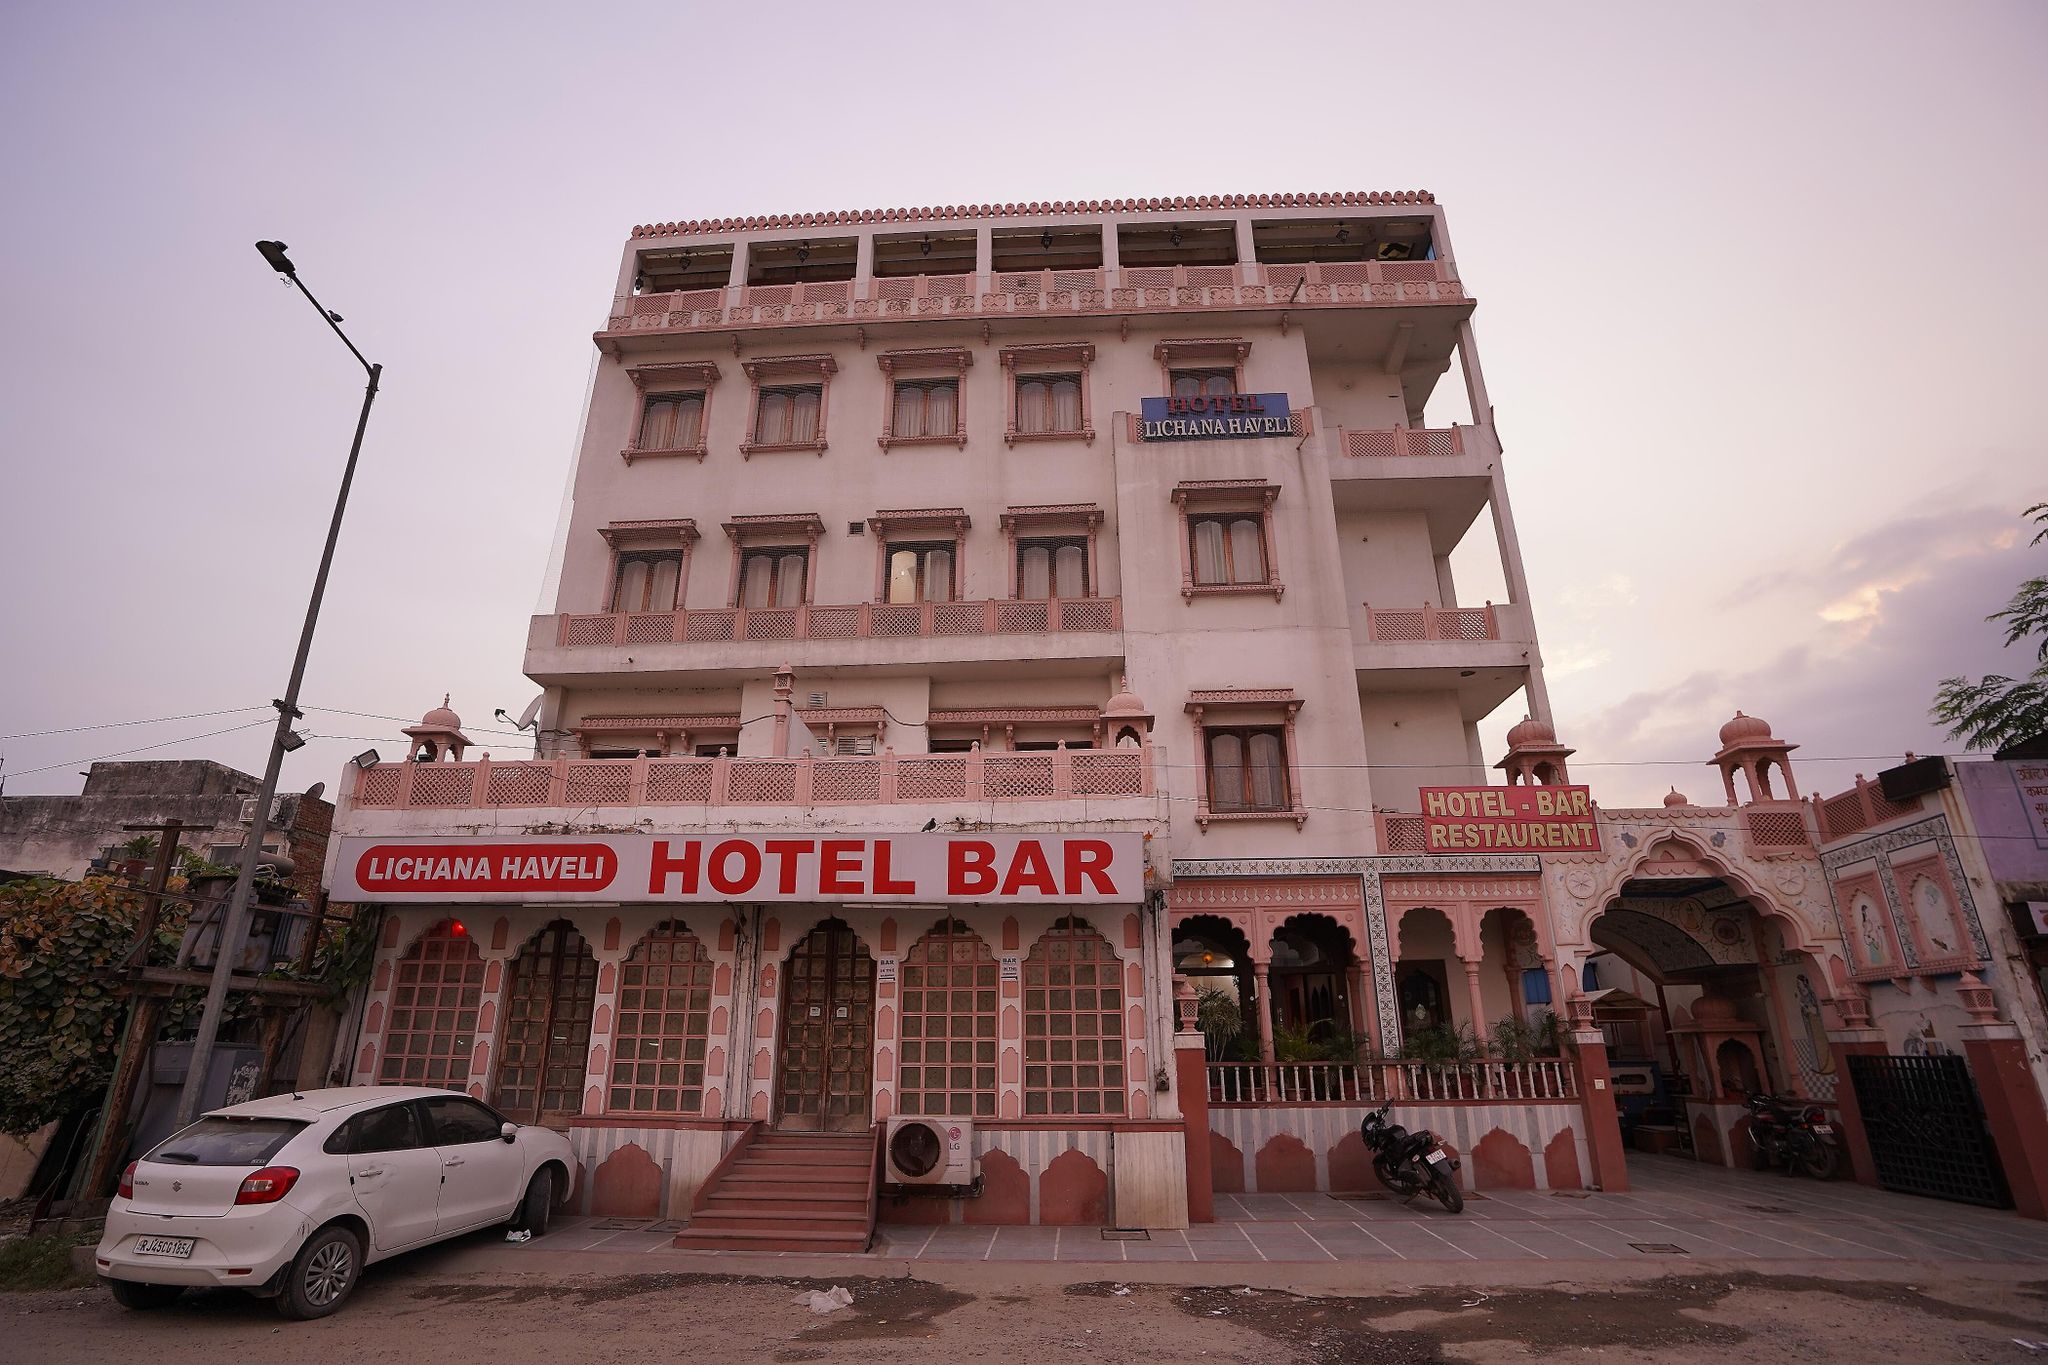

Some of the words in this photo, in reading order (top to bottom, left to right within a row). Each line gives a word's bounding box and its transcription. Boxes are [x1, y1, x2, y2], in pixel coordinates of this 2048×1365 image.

[1167, 396, 1265, 414] HOTEL
[1145, 418, 1226, 437] LICHANA
[1229, 417, 1293, 434] HAVELI
[1427, 791, 1515, 817] HOTEL
[1535, 791, 1589, 816] BAR
[1430, 823, 1593, 848] RESTAURENT
[368, 857, 491, 880] LICHANA
[501, 856, 604, 880] HAVELI
[648, 839, 916, 895] HOTEL
[947, 840, 1119, 896] BAR
